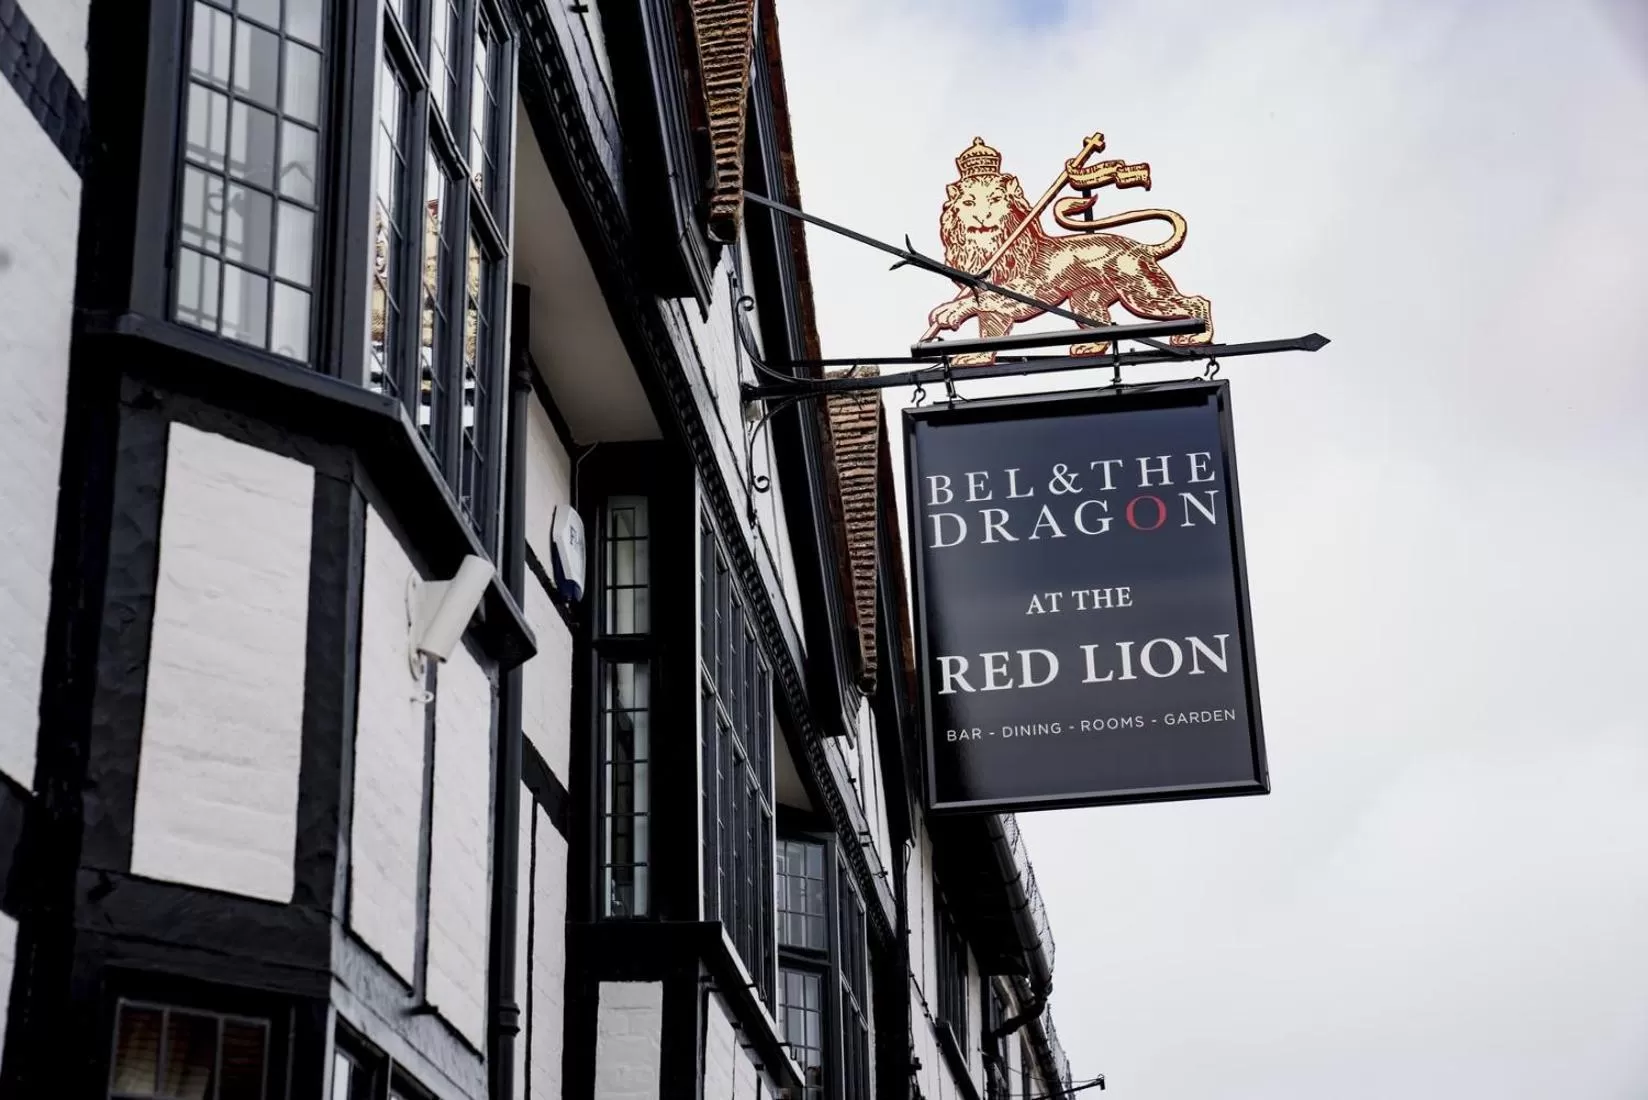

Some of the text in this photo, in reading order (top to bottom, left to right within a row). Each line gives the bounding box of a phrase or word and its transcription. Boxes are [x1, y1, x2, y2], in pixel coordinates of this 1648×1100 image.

[928, 489, 1220, 549] DRAGON
[1025, 586, 1134, 616] AT THE
[936, 633, 1230, 695] RED LION
[946, 727, 982, 742] BAR
[1001, 722, 1062, 739] DINING
[1080, 715, 1145, 732] ROOMS
[1163, 708, 1236, 726] GARDEN
